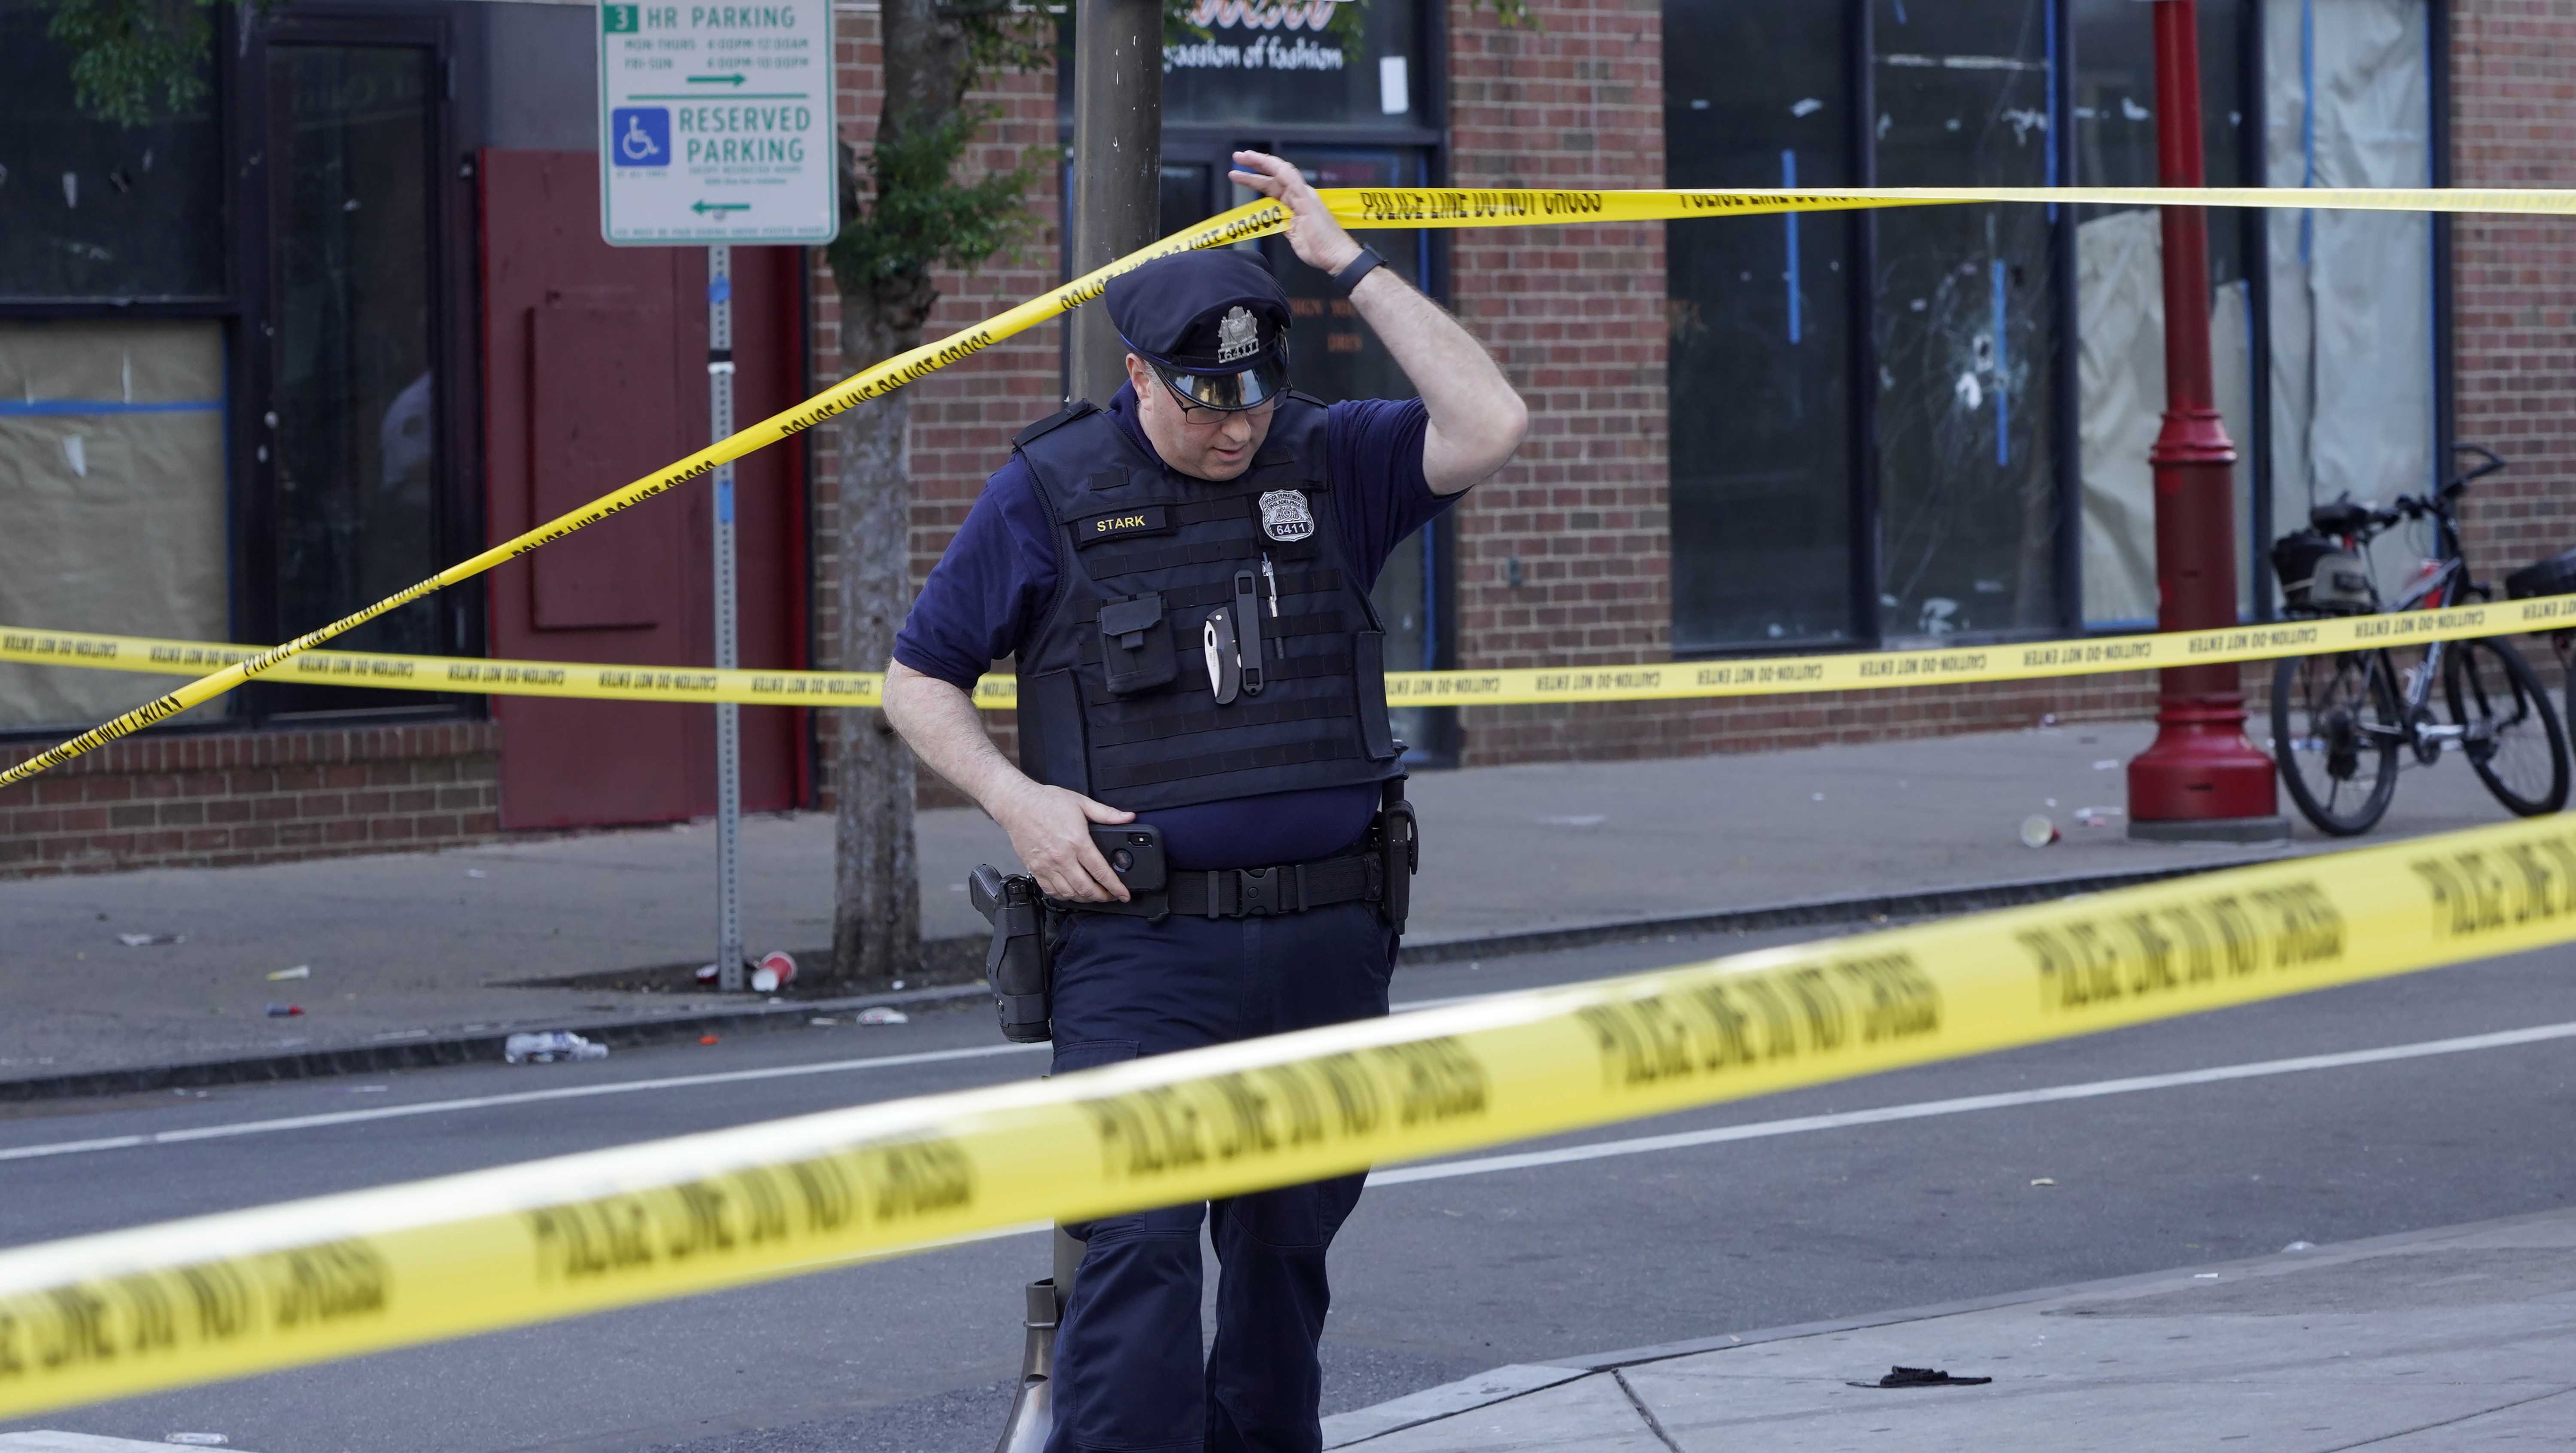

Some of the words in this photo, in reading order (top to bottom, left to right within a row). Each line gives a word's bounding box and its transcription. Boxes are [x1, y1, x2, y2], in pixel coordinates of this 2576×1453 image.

[615, 5, 629, 30] 3
[647, 6, 677, 28] HR
[692, 6, 796, 29] PARKING
[1243, 35, 1267, 69] of
[1268, 36, 1342, 70] fashion
[679, 107, 811, 131] RESERVED
[688, 138, 804, 162] PARKING
[1360, 192, 1423, 220] POLICE
[1427, 192, 1467, 219] LINE
[1224, 342, 1253, 360] 6411
[1264, 495, 1278, 504] POLICE
[1269, 499, 1301, 510] PHILADELPHIA
[1097, 515, 1145, 532] STARK
[1277, 523, 1305, 535] 6411
[2523, 602, 2557, 621] ENTER
[1385, 679, 1409, 696] ENT
